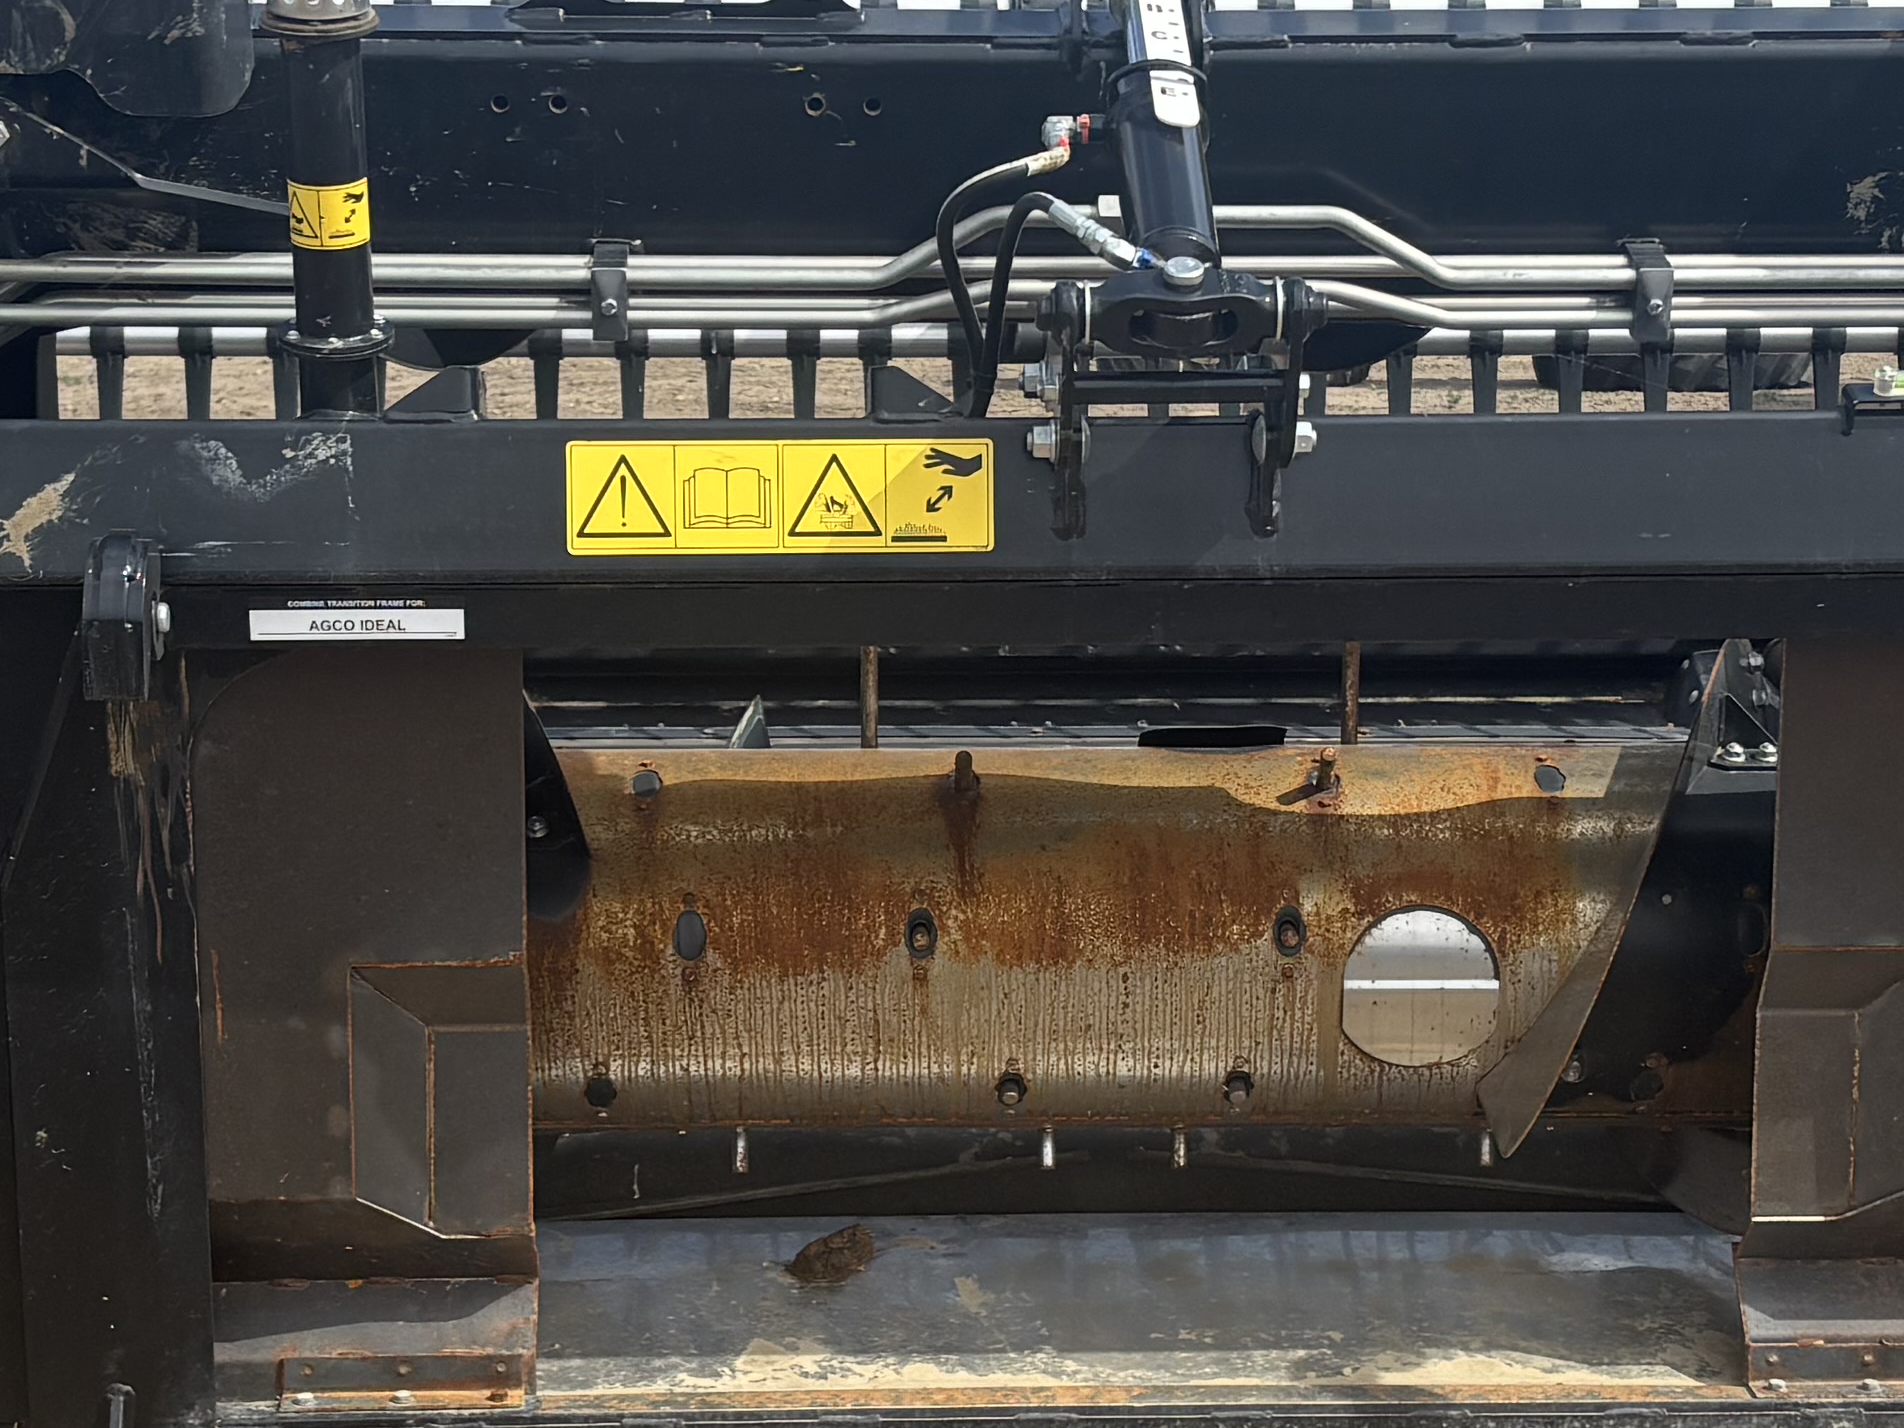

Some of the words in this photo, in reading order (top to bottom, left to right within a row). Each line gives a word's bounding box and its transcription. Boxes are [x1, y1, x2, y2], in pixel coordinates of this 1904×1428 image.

[1151, 31, 1168, 40] C
[309, 620, 355, 632] AGCO
[361, 620, 406, 632] IDEAL
